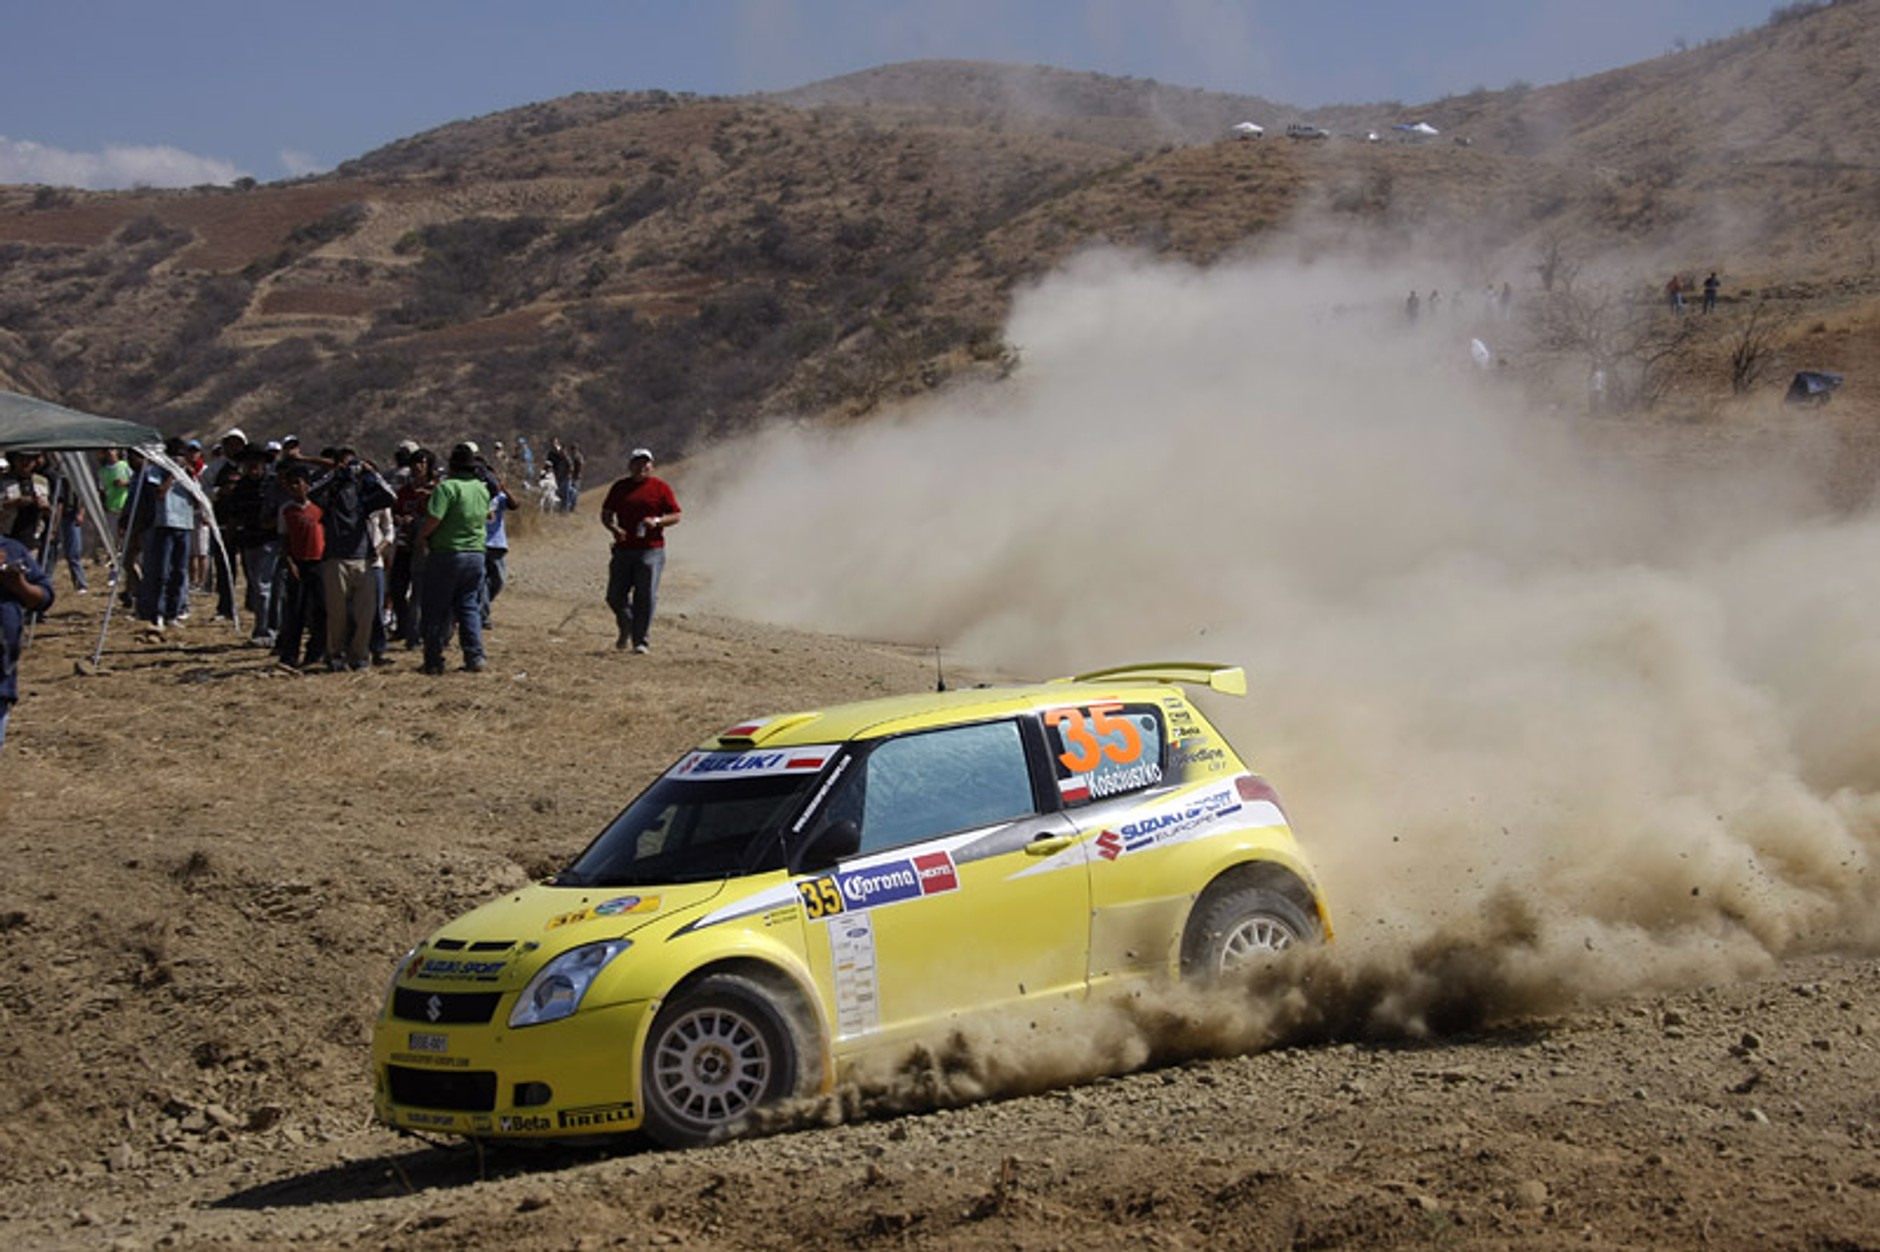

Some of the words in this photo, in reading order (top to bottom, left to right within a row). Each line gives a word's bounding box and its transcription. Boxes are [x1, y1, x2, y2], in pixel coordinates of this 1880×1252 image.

[1045, 700, 1142, 773] 35
[690, 753, 785, 773] SUZUKI
[1121, 812, 1183, 841] SUZUKI
[801, 878, 842, 918] 35
[843, 869, 916, 902] Corona
[513, 1115, 550, 1132] Beta
[558, 1102, 634, 1129] PIRELLI
